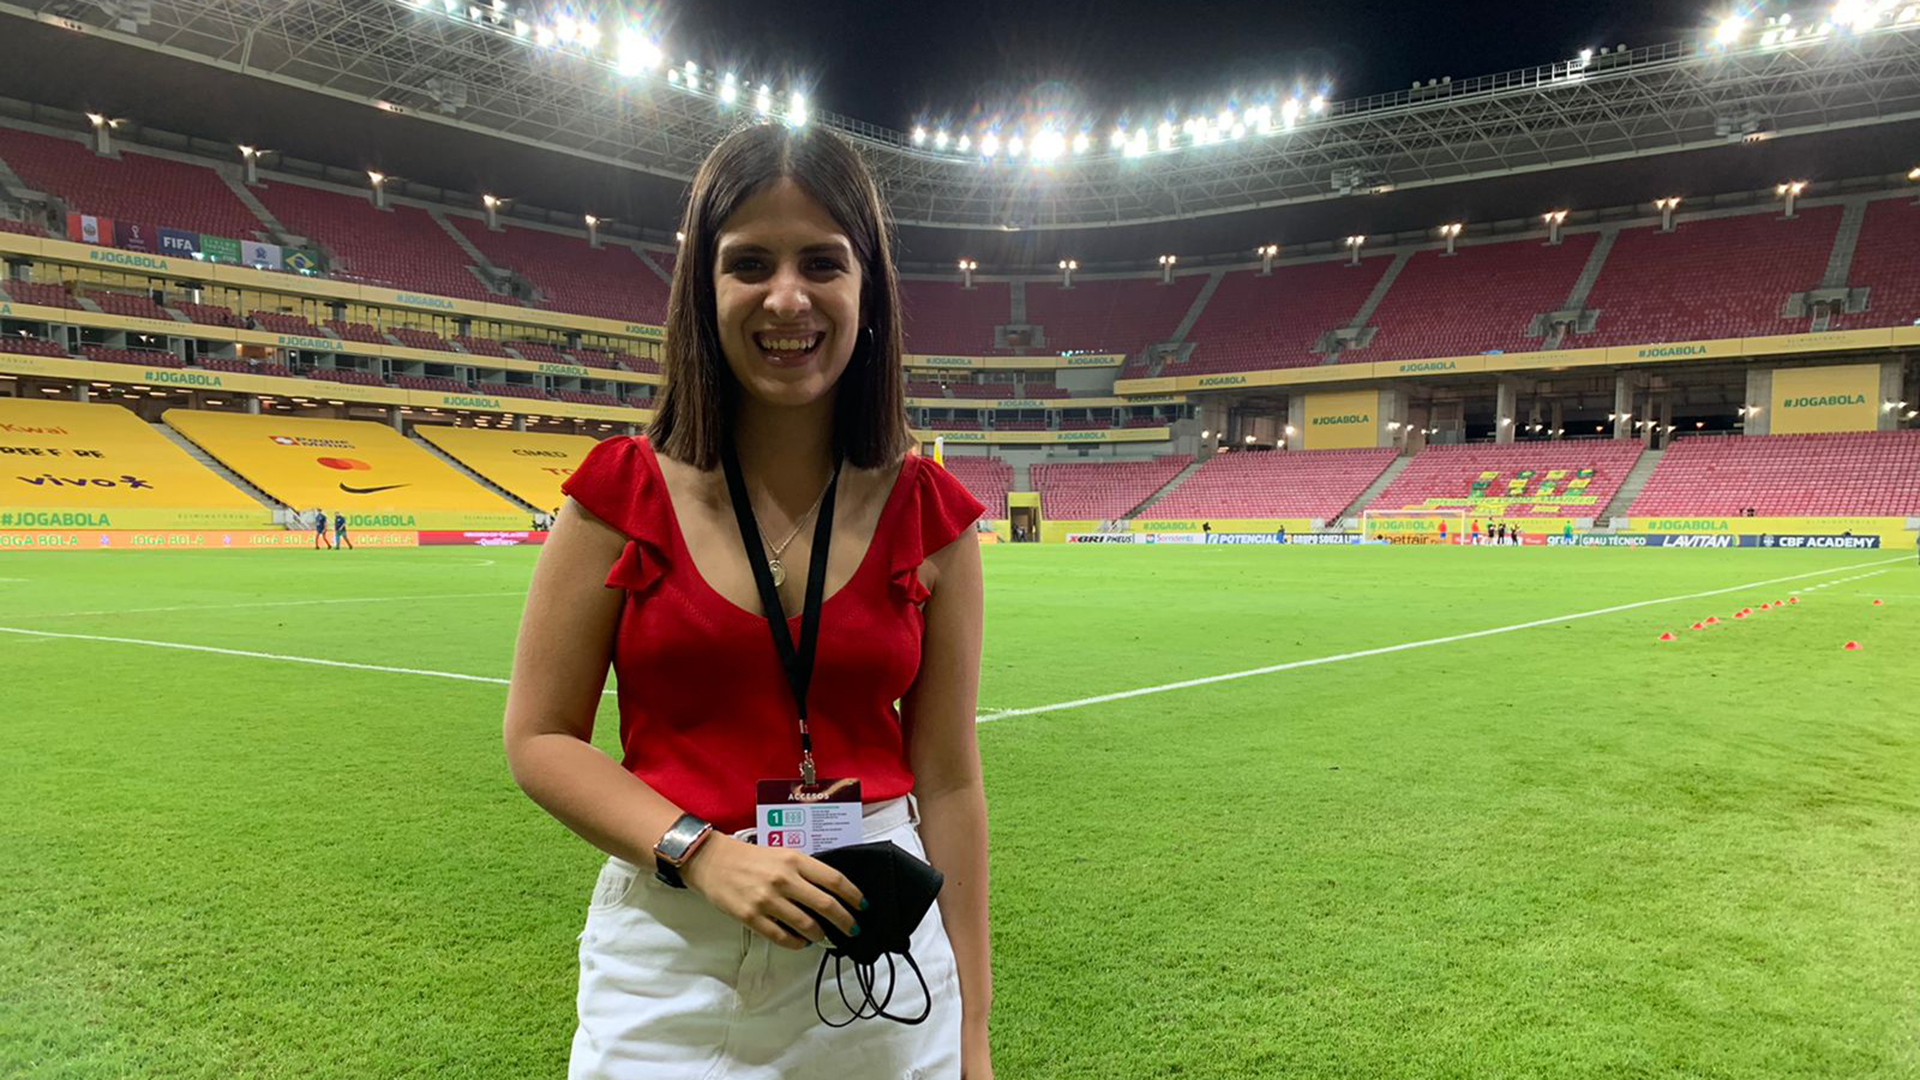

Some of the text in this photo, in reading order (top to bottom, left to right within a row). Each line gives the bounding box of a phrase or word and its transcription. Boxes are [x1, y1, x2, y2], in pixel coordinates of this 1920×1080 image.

[163, 236, 194, 250] FIFA
[90, 250, 168, 270] #JOGABOLA
[397, 293, 454, 309] #JOGABOLA
[626, 325, 663, 336] #JOGABOL
[278, 335, 343, 350] #JOGABOLA
[1639, 345, 1706, 357] #JOGABOLA
[1067, 356, 1114, 365] #JOGABOLA
[1400, 361, 1456, 371] #JOGABOLA
[538, 363, 588, 376] #JOGABOLA
[145, 371, 222, 387] #JOGABOLA
[1199, 376, 1246, 386] #JOGABOLA
[443, 396, 499, 408] #JOGABOLA
[1784, 394, 1865, 408] #JOGABOLA
[1313, 414, 1369, 425] #JOGABOLA
[1057, 432, 1106, 440] #JOGABOLA
[0, 446, 105, 459] REE FRE
[16, 474, 116, 487] vivo
[1, 512, 111, 527] #JOGABOLA
[345, 515, 416, 528] JOGABOLA
[1649, 520, 1729, 530] #JOGABOLA
[1143, 522, 1197, 530] #JOGABOLA
[1369, 521, 1435, 531] #JOGABOLA
[0, 535, 77, 547] OGA BOLA
[1106, 535, 1133, 544] PNEUS
[1220, 534, 1277, 544] POTENCIAL
[1319, 534, 1344, 544] SOUZA
[1583, 535, 1647, 546] GRAU TÉCNICO
[1662, 535, 1731, 547] LAVITAN
[1779, 536, 1875, 547] CBF ACADEMY
[788, 792, 830, 801] ACCESOS
[772, 812, 779, 824] 1
[771, 834, 781, 846] 2
